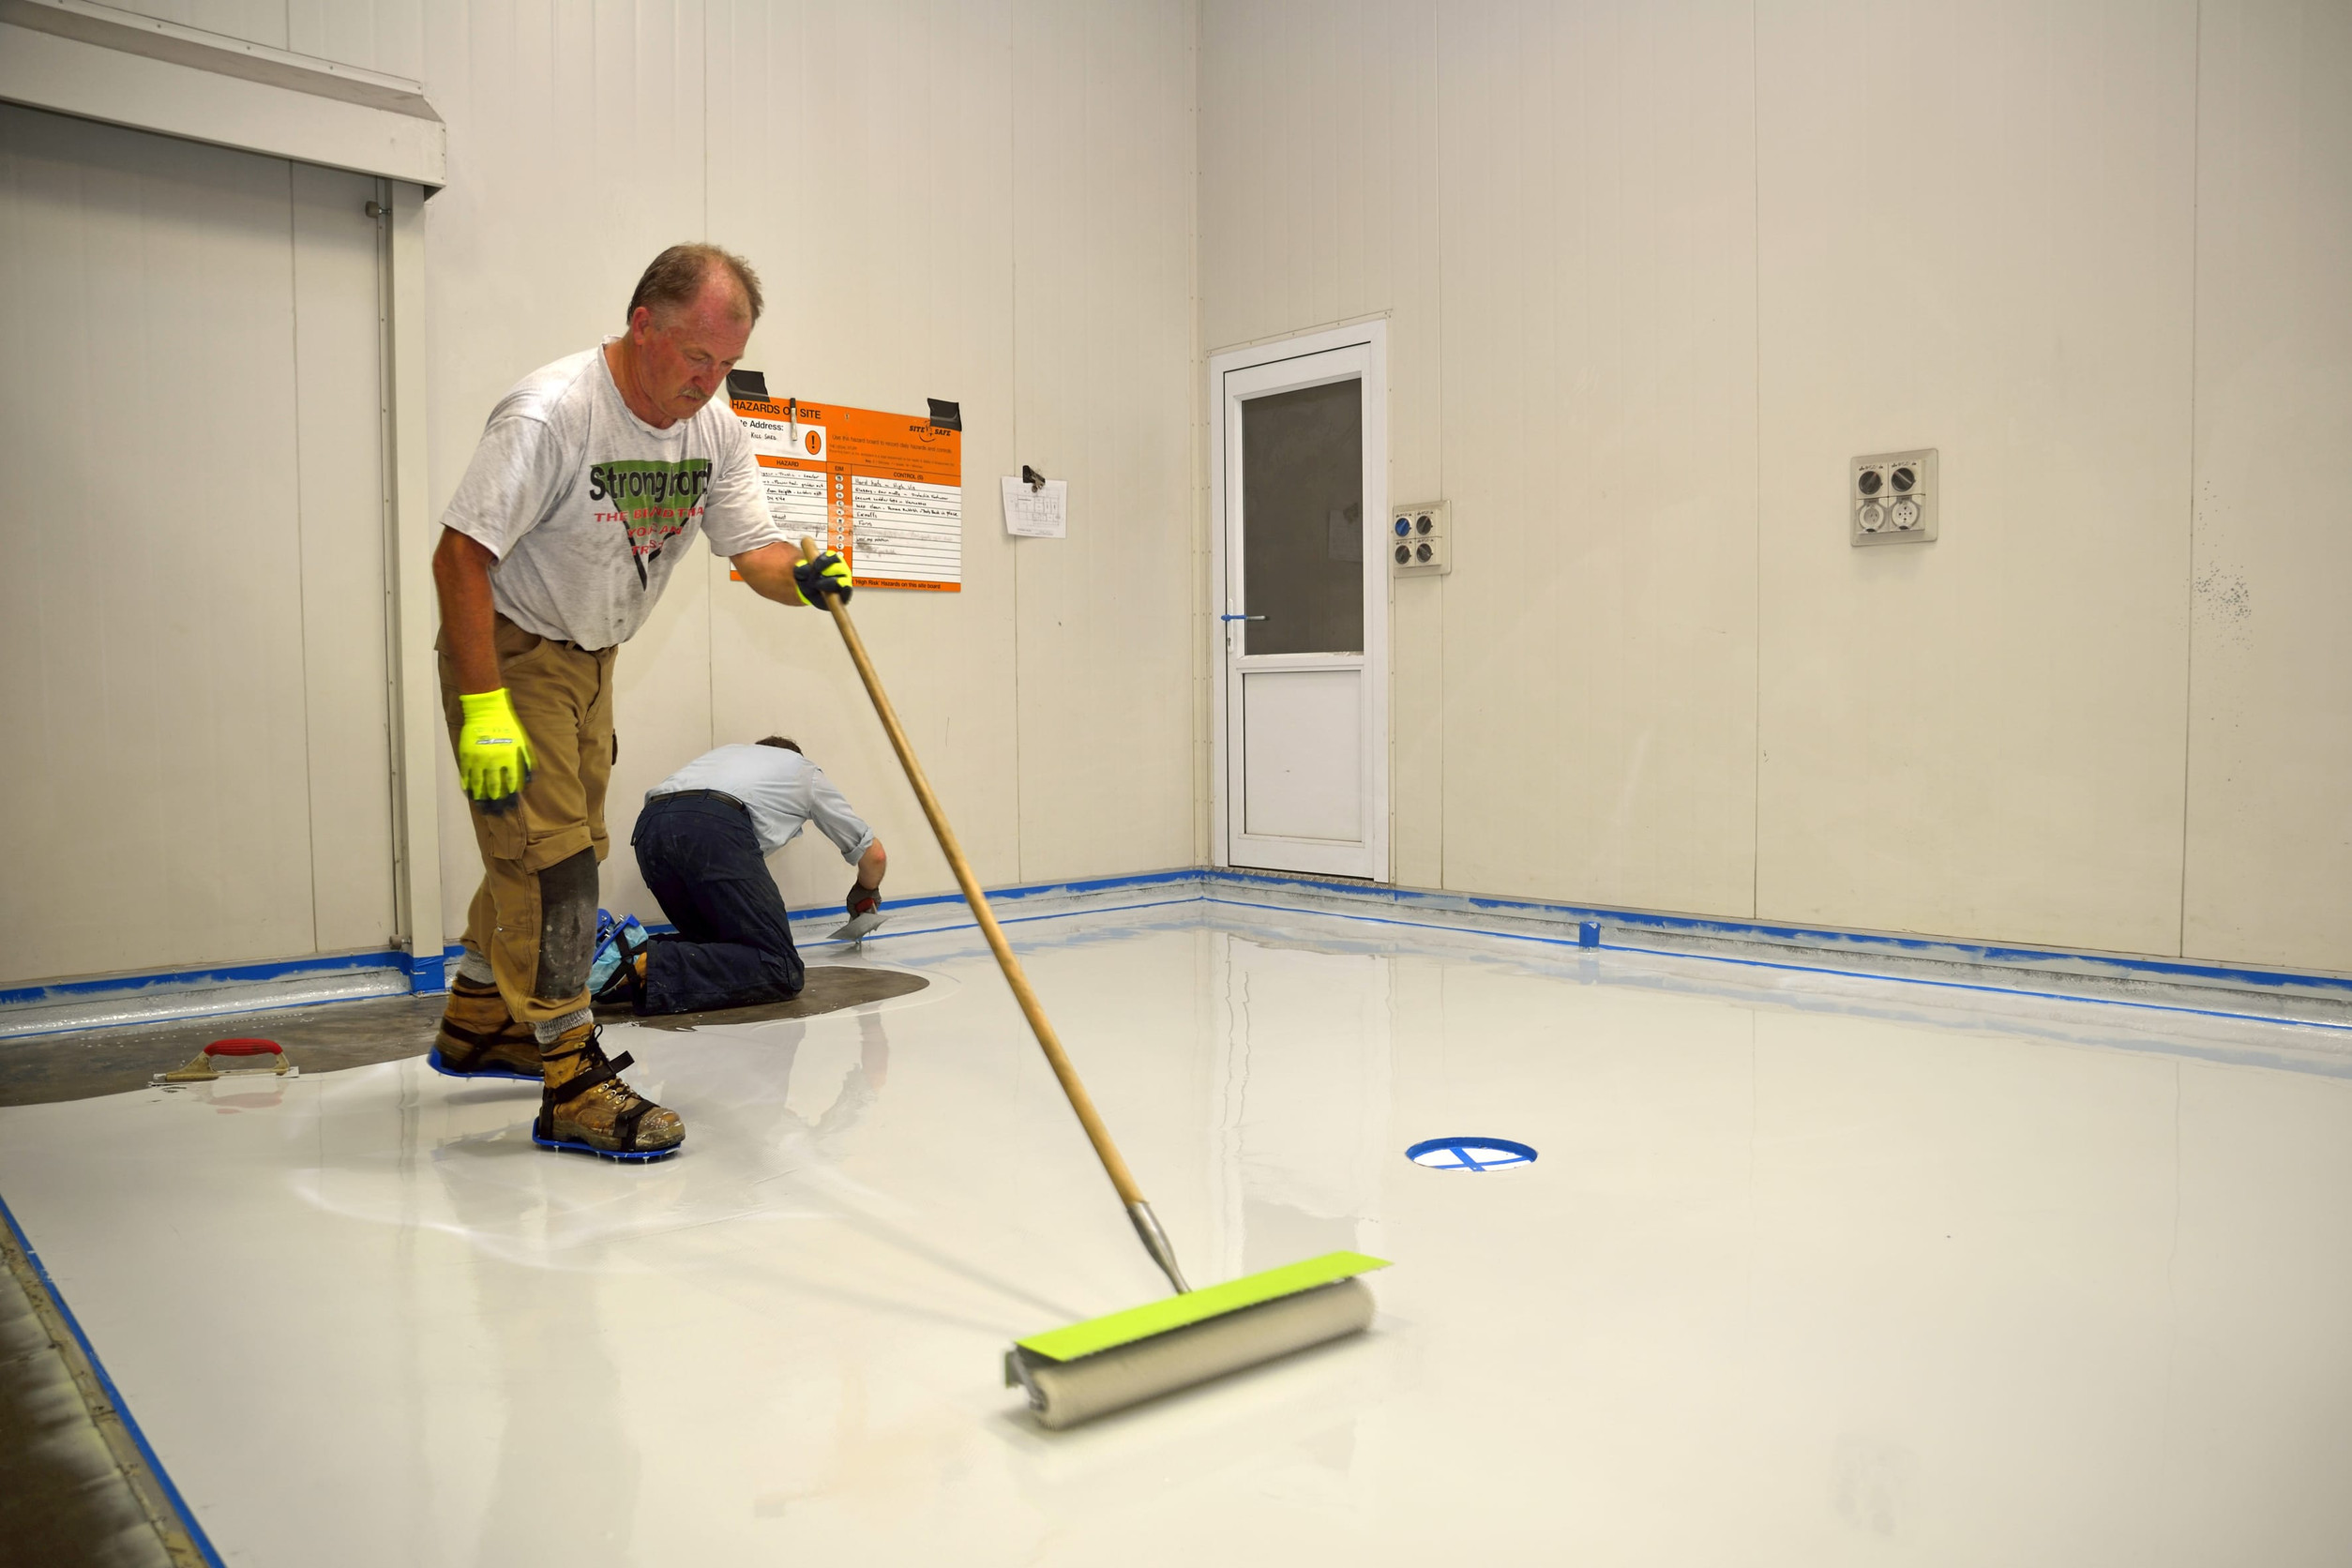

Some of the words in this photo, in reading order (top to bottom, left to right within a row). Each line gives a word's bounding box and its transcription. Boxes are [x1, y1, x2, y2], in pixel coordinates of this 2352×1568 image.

[731, 400, 780, 415] HAZARDS
[800, 408, 822, 419] SITE
[749, 419, 784, 431] Address:
[909, 425, 925, 433] SITE
[594, 511, 629, 522] THE
[633, 505, 674, 520] BIND
